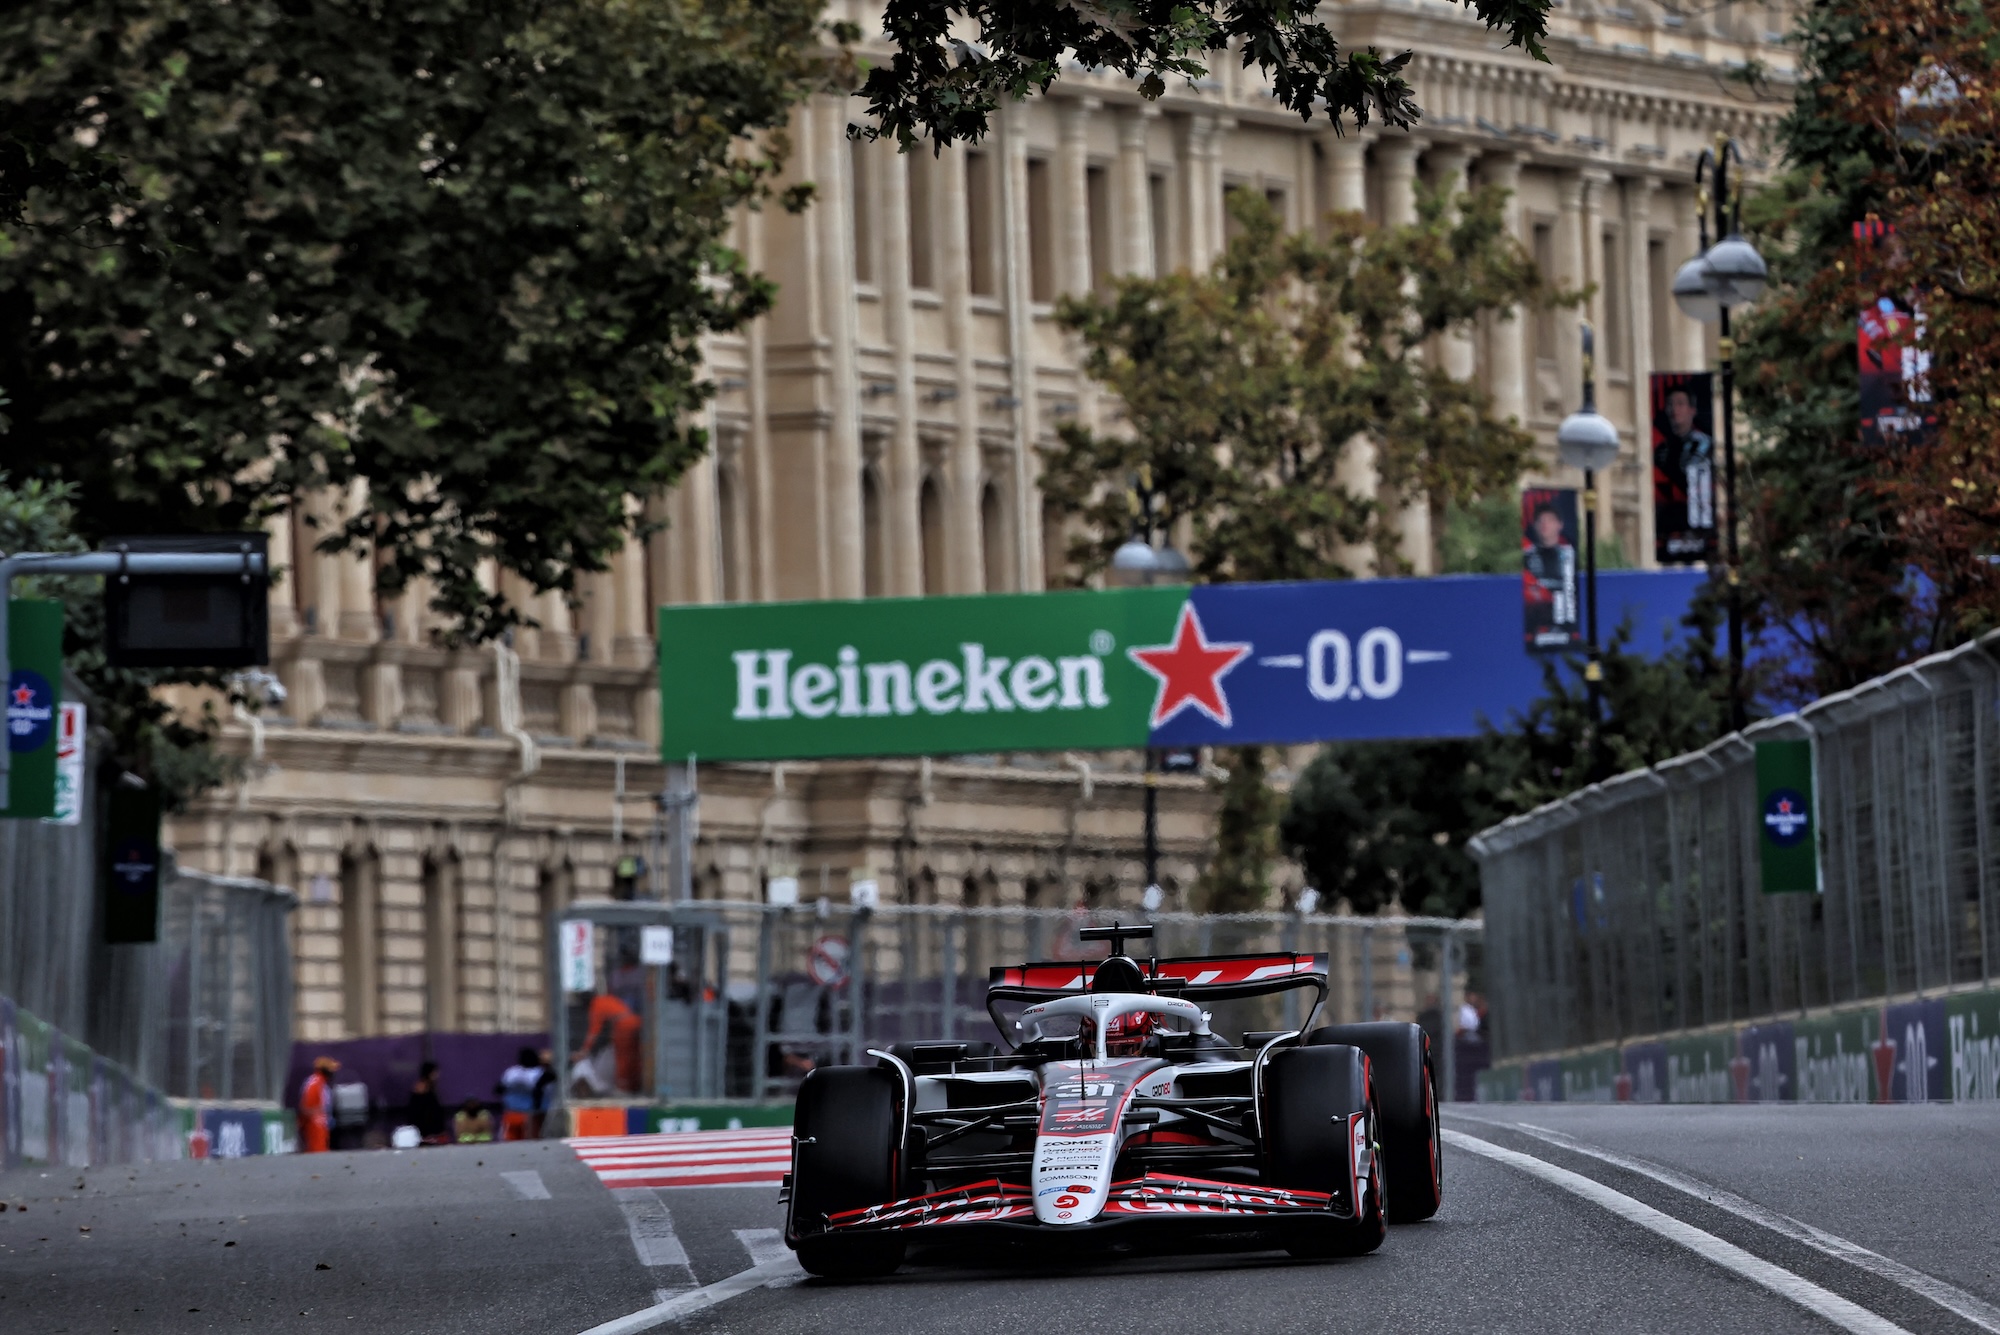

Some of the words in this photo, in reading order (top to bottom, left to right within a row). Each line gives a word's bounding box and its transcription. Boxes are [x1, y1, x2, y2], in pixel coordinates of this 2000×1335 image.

[731, 641, 1110, 719] Heineken
[1949, 1010, 2000, 1103] Heine
[1056, 1083, 1115, 1098] 31
[1042, 1140, 1104, 1148] ZOOMEX
[1040, 1164, 1099, 1173] PIRELLI
[1039, 1174, 1099, 1184] COMMSCOPE
